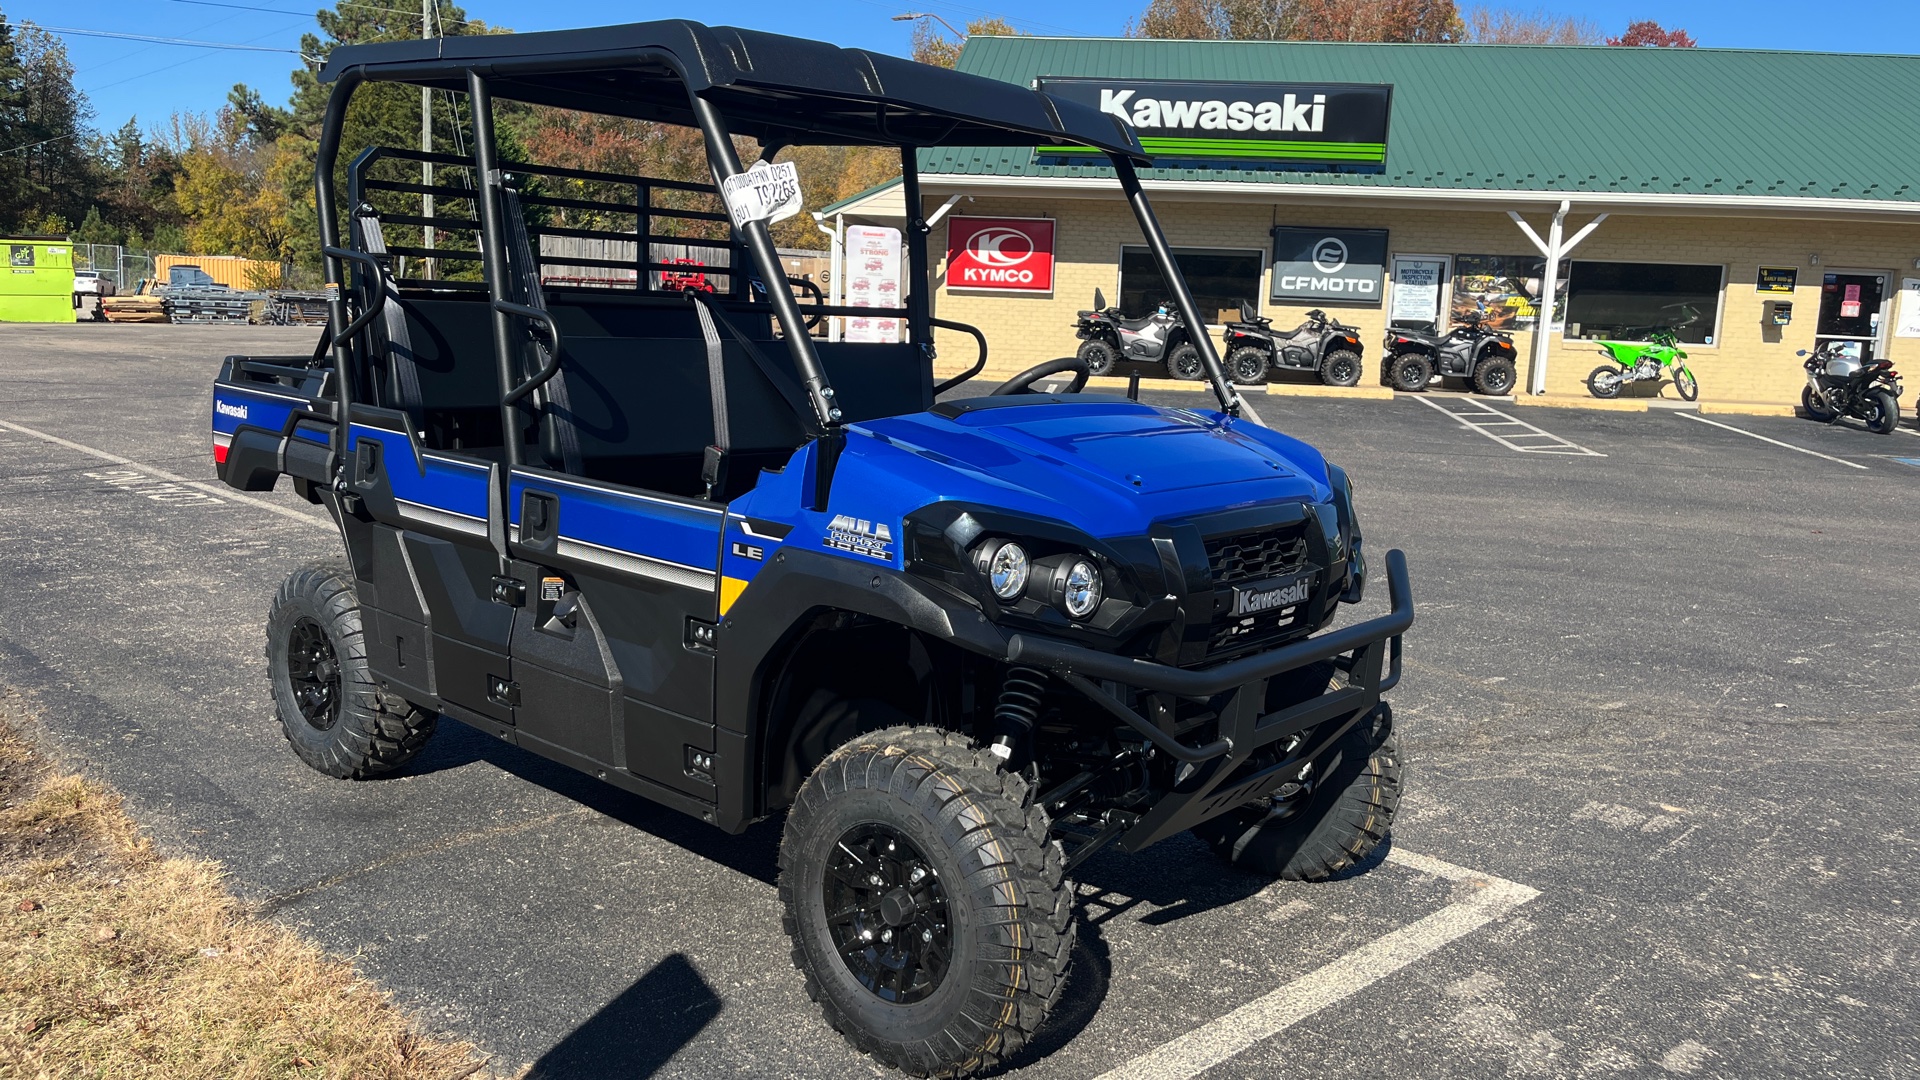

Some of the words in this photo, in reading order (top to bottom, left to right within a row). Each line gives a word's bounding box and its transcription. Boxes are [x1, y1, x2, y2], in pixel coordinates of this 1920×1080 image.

[1100, 88, 1326, 132] Kawasaki
[964, 268, 1034, 283] KYMCO
[1281, 275, 1376, 293] CFMOTO
[216, 399, 248, 420] Kawasaki
[732, 543, 763, 560] LE
[1239, 578, 1309, 614] Kawasaki
